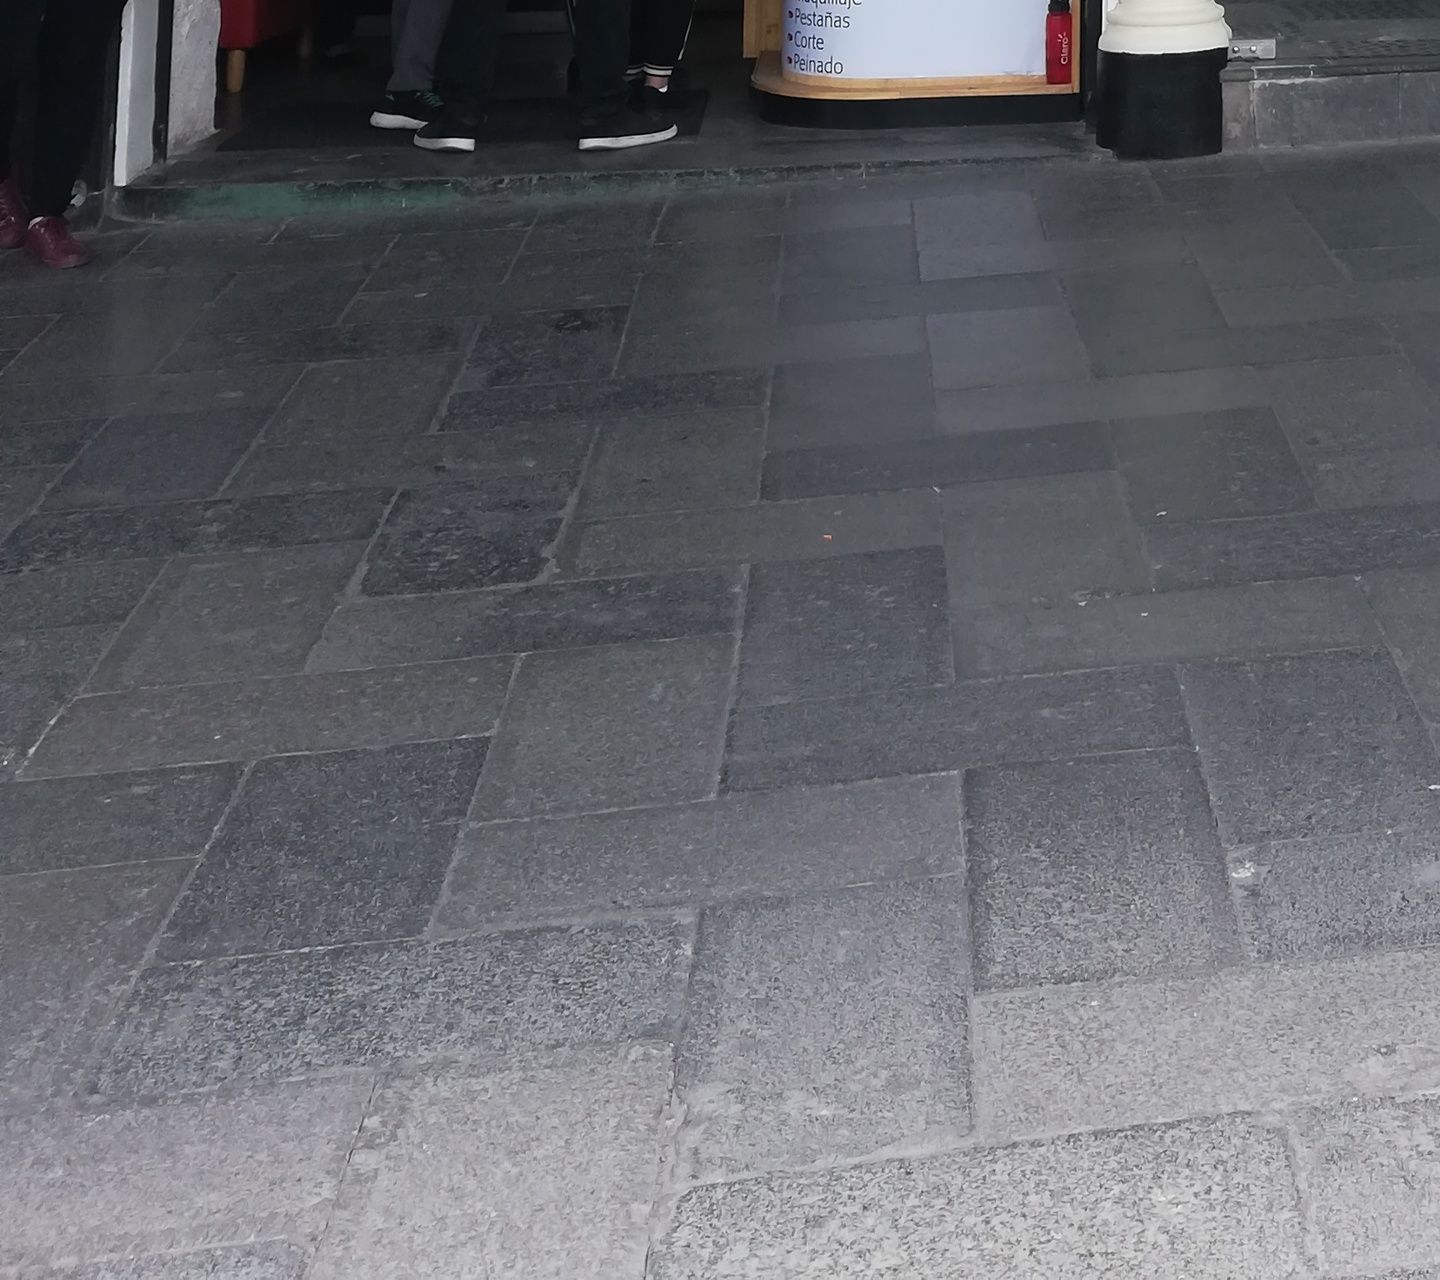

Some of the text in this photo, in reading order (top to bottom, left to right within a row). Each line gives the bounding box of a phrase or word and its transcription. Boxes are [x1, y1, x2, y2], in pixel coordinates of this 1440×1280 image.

[795, 7, 850, 28] Pestañas
[794, 31, 825, 50] Corte
[1060, 36, 1069, 65] Claro
[793, 53, 844, 74] Peinado
